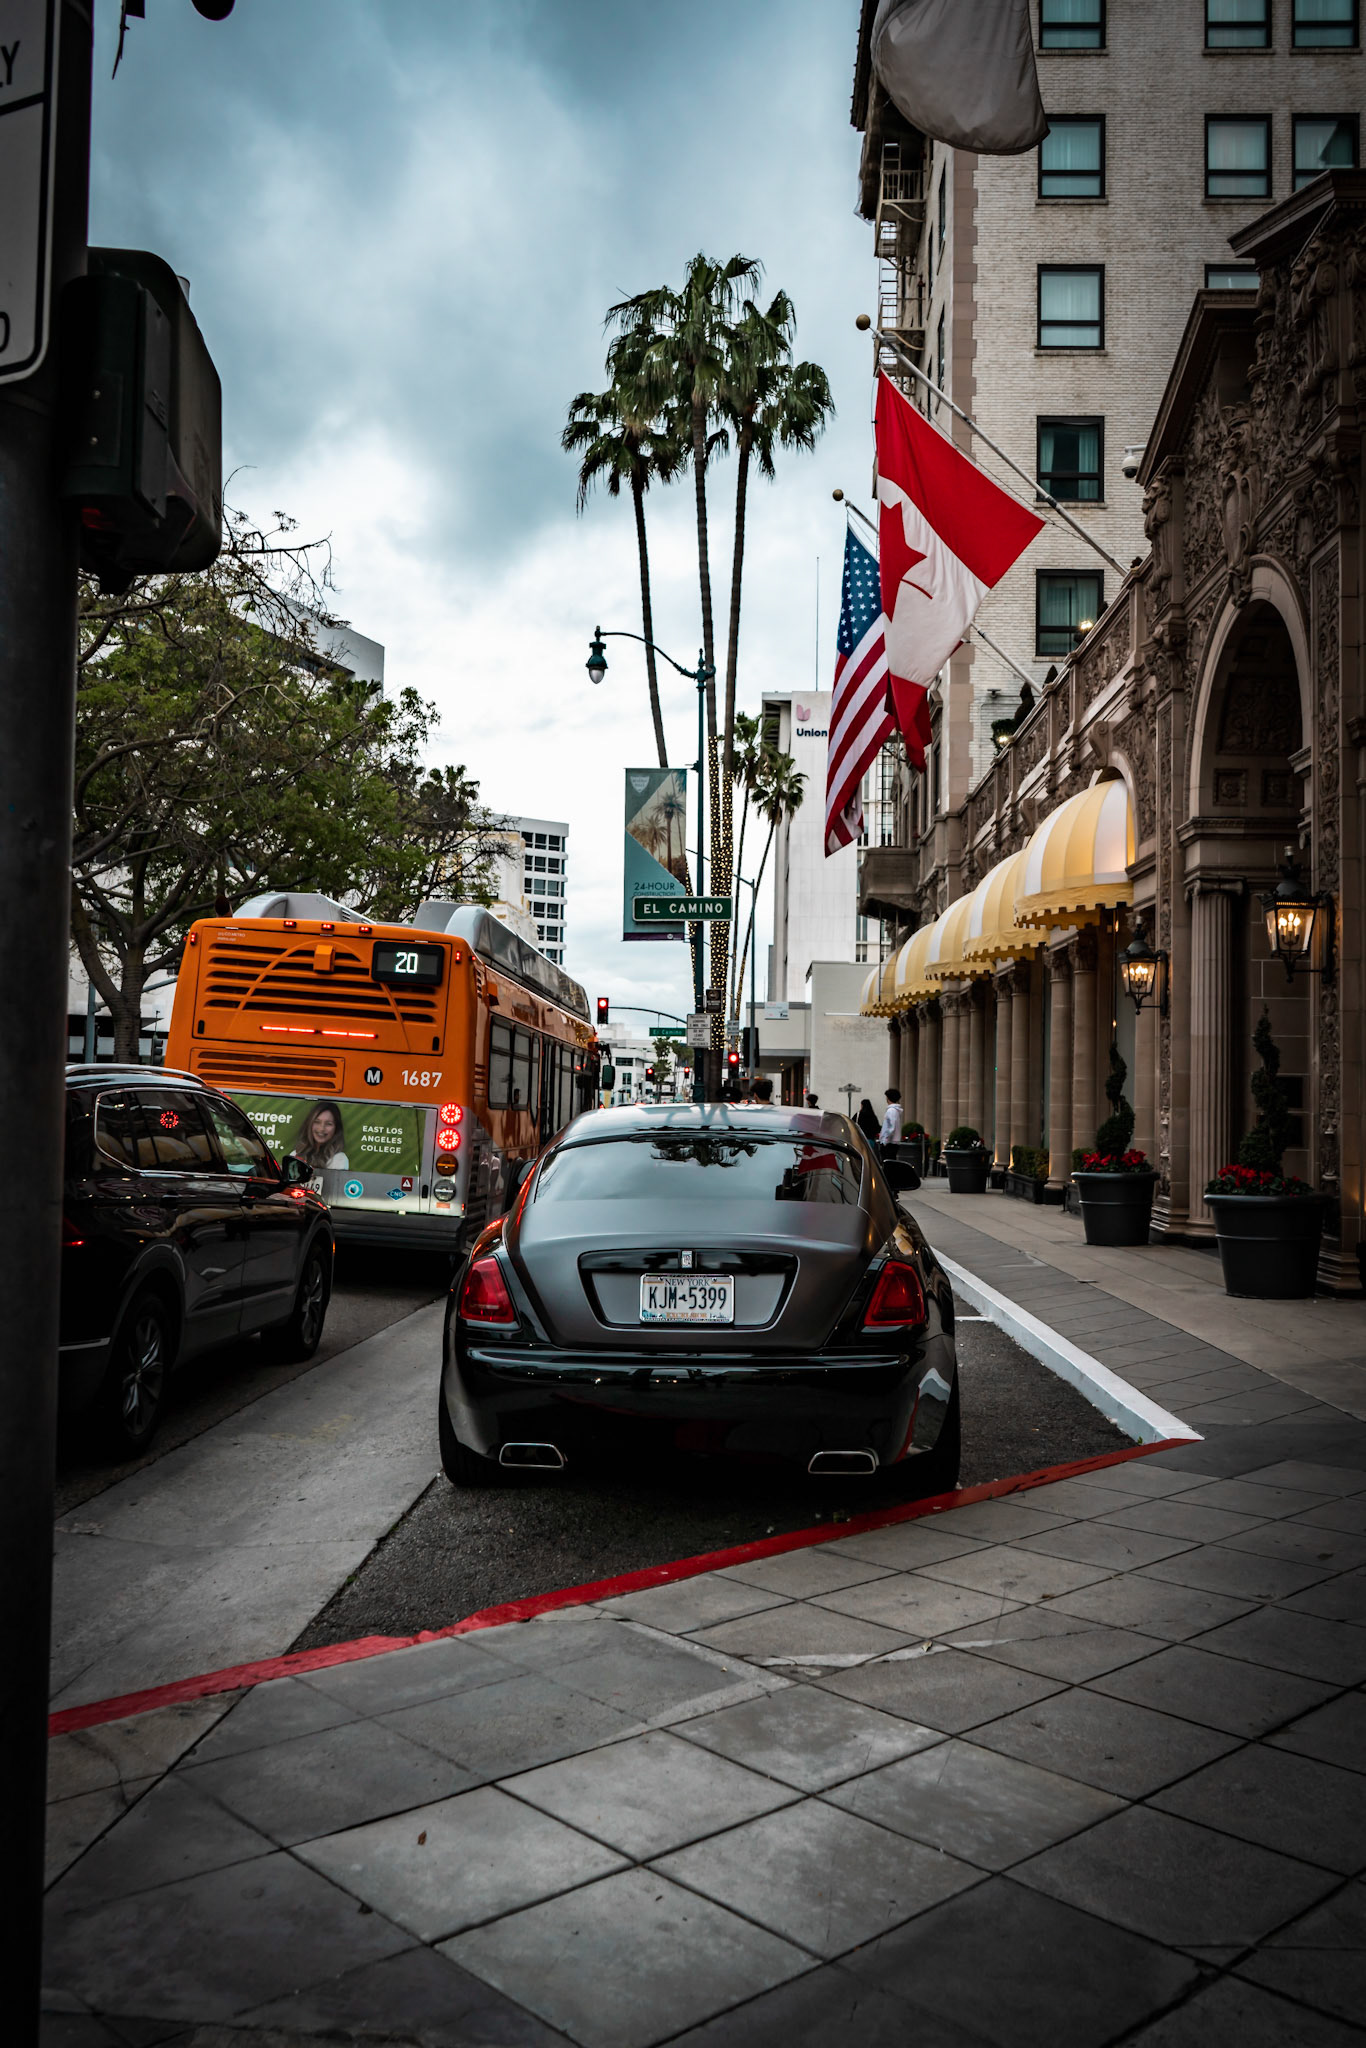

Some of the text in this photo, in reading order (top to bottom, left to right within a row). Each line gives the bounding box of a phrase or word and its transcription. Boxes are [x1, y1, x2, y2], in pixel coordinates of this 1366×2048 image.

[796, 728, 828, 737] Union
[634, 882, 675, 891] 24-HOUR
[643, 903, 724, 914] EL CAMINO
[395, 952, 419, 974] 20
[366, 1069, 381, 1083] M
[401, 1070, 443, 1088] 1687
[246, 1110, 293, 1124] career
[362, 1125, 403, 1135] EAST LOS
[361, 1135, 403, 1145] ANGELES
[360, 1144, 402, 1154] COLLEGE
[389, 1190, 404, 1198] CNG
[664, 1278, 710, 1287] NEW YORK
